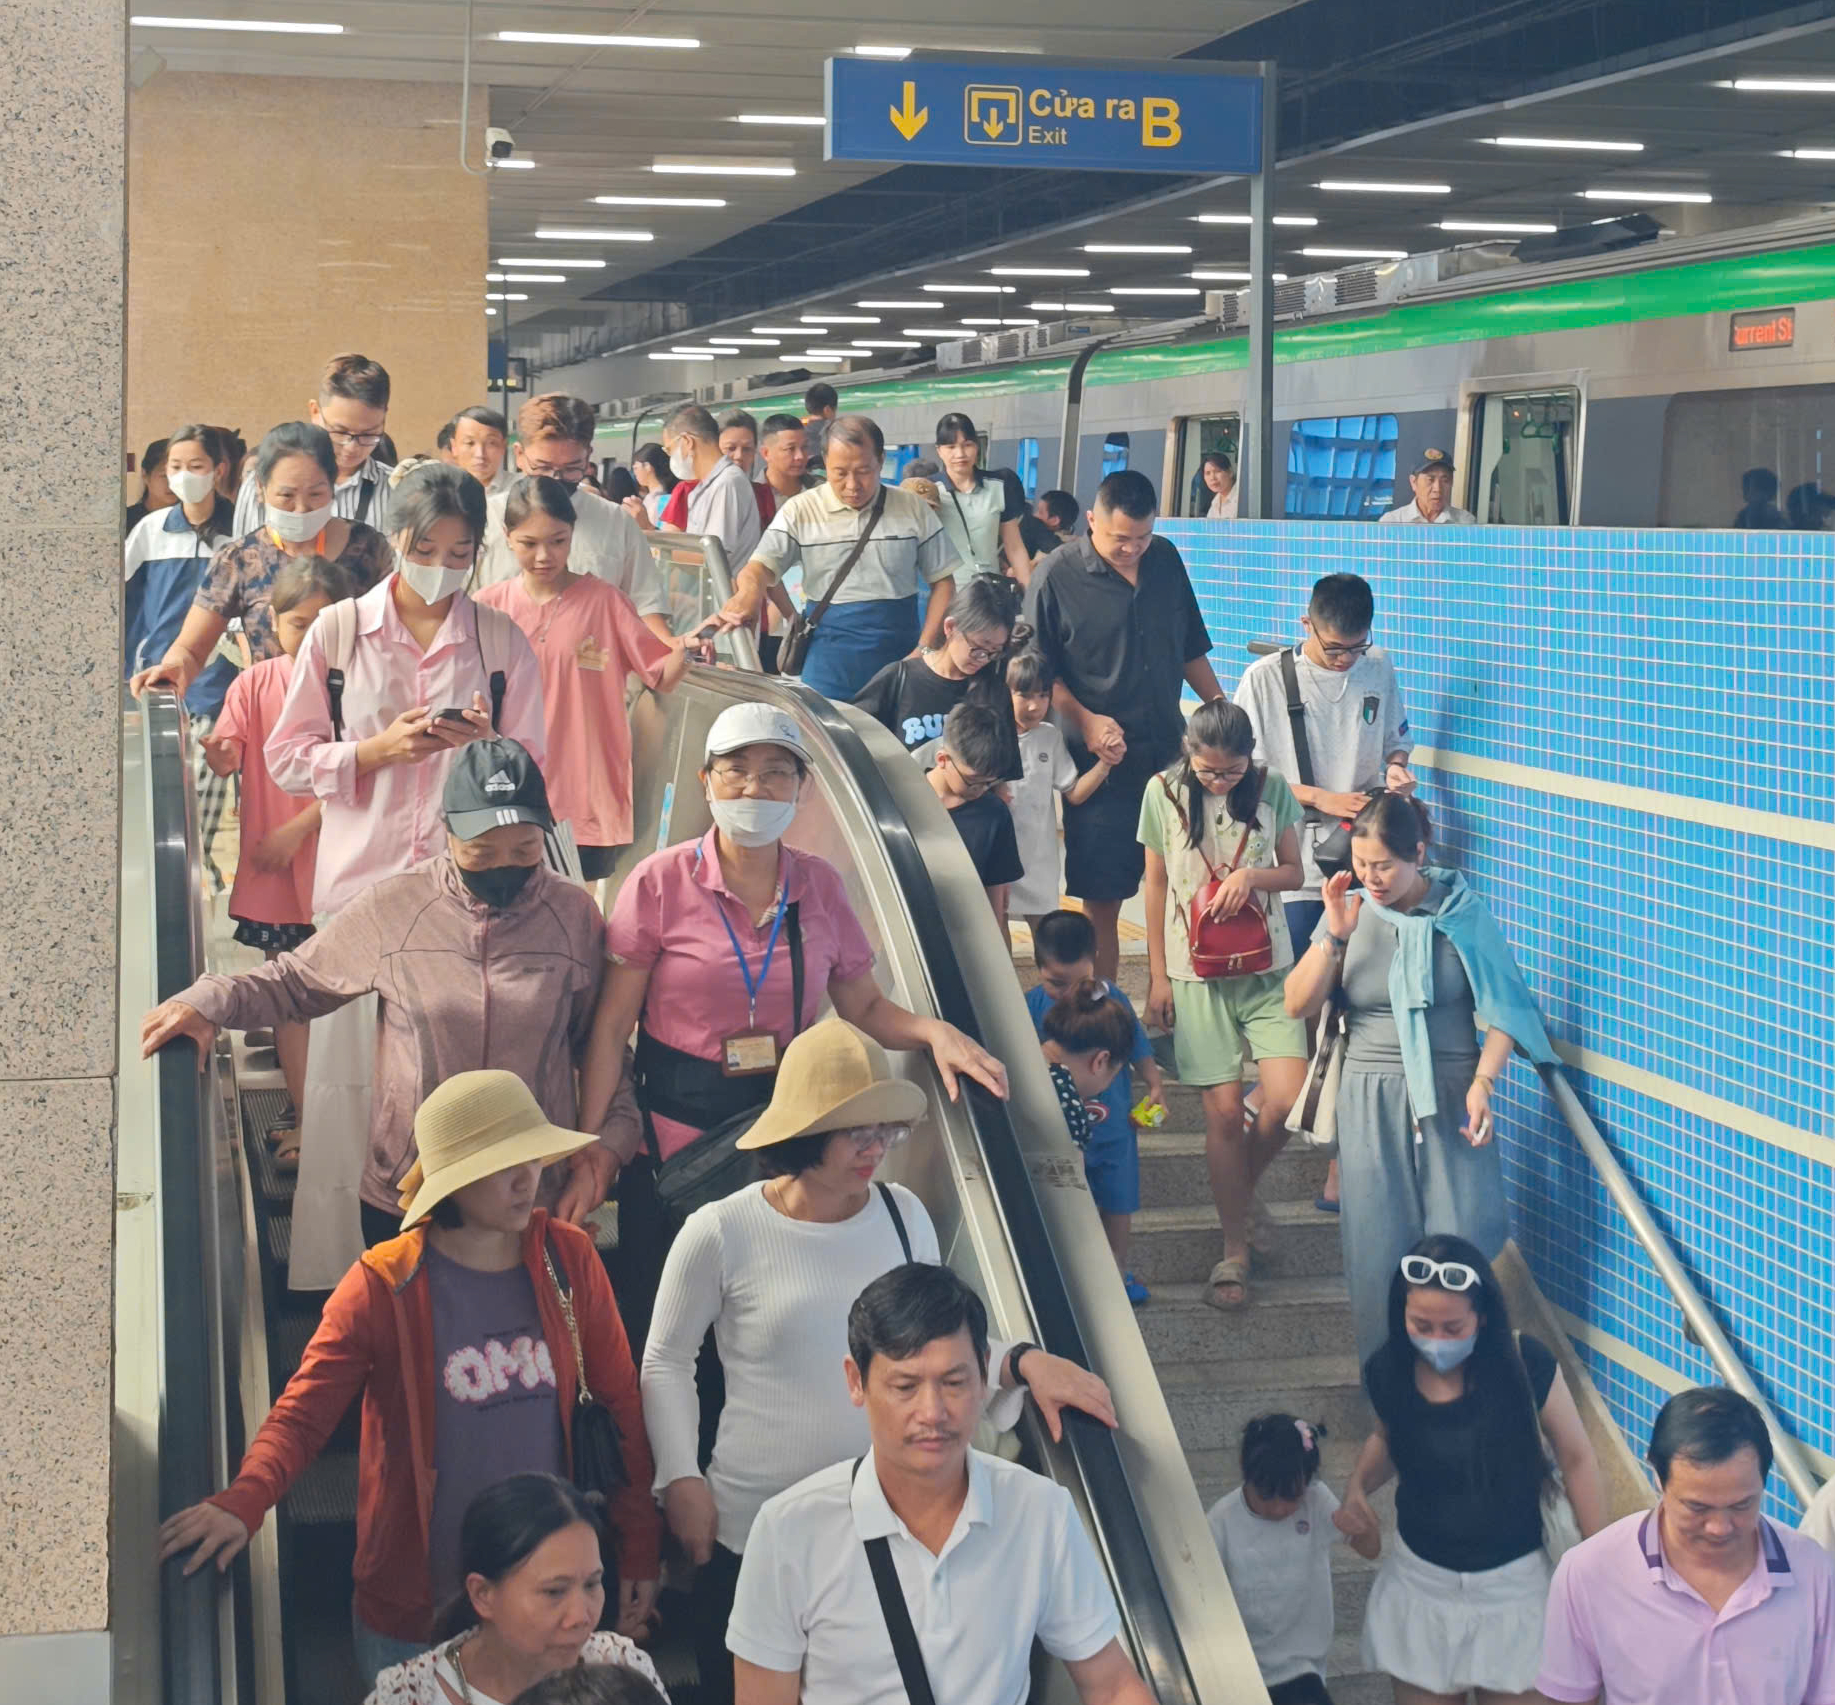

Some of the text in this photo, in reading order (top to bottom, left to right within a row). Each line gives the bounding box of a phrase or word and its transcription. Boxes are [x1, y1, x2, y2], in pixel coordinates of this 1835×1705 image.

[1028, 126, 1067, 145] Exit
[1029, 89, 1182, 147] Cửa ra B
